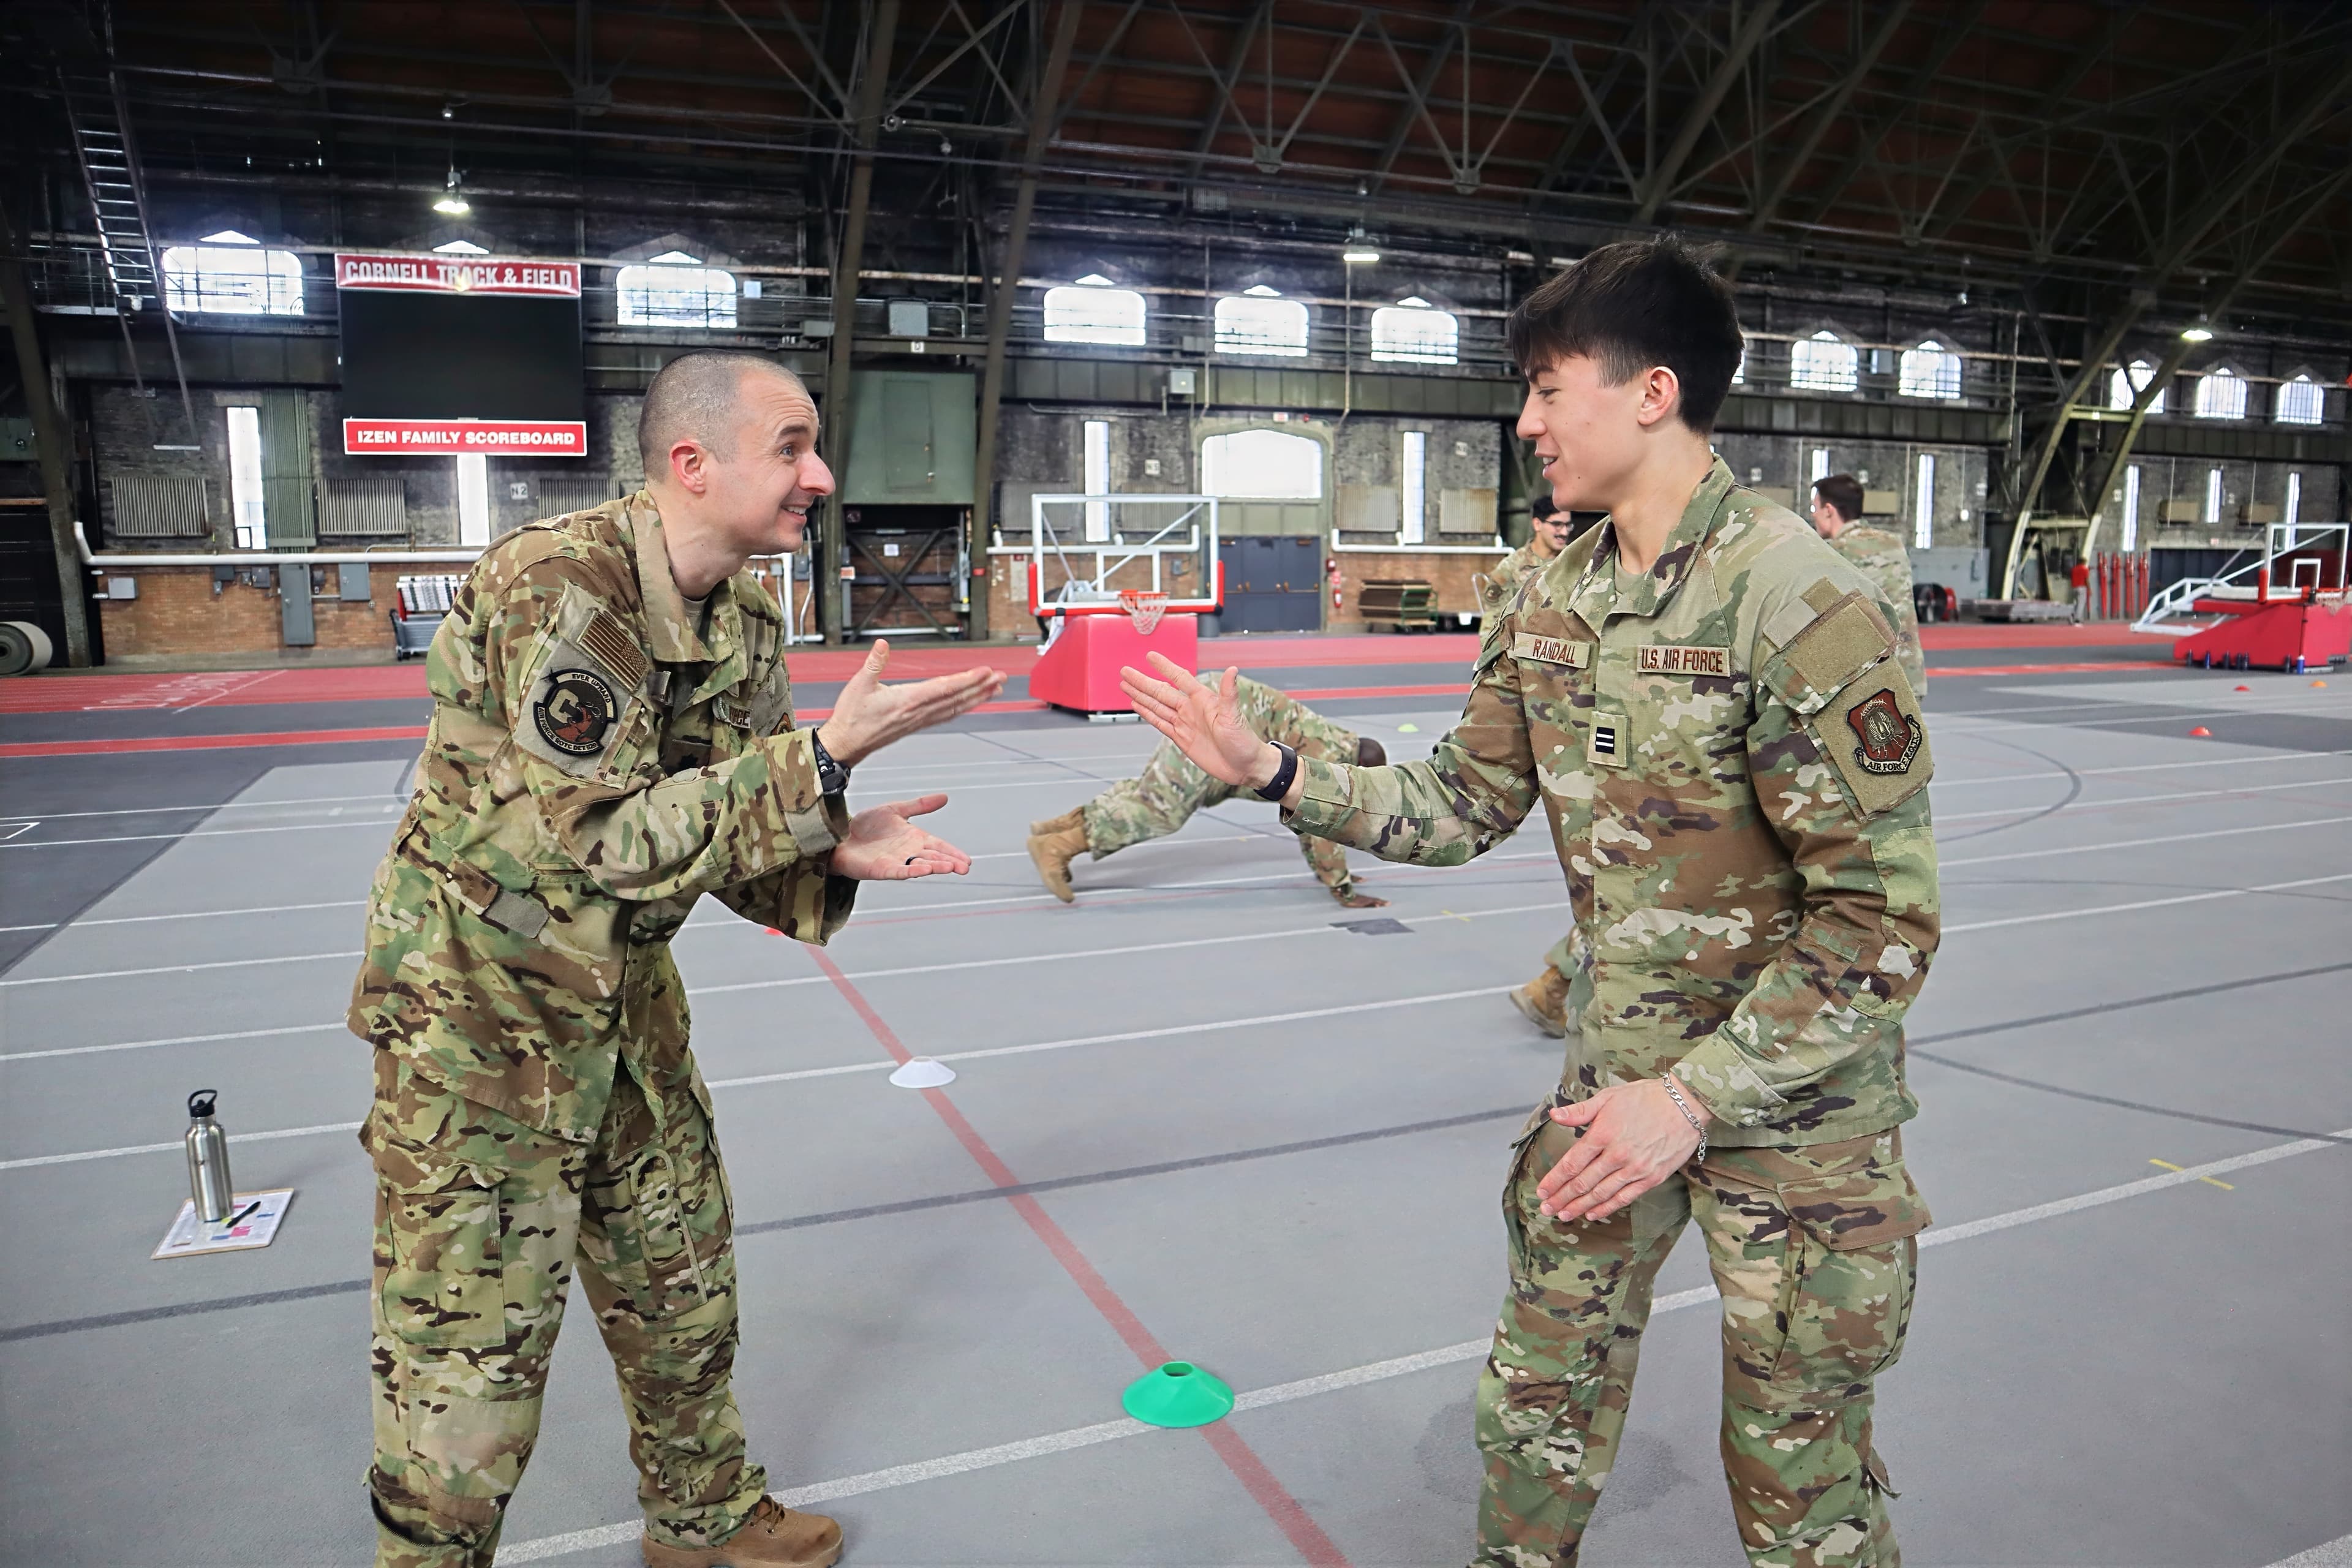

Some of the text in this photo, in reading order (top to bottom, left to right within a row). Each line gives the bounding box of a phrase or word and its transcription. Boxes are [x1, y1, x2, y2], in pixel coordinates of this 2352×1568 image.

[345, 261, 572, 288] CORNELL TRACK & FIELD
[357, 431, 575, 445] IZEN FAMILY SCOREBOARD
[1532, 639, 1575, 664] RANDALL
[1642, 649, 1723, 673] U.S. AIR FORCE
[1866, 761, 1881, 771] AIR
[1883, 758, 1909, 771] FORCE
